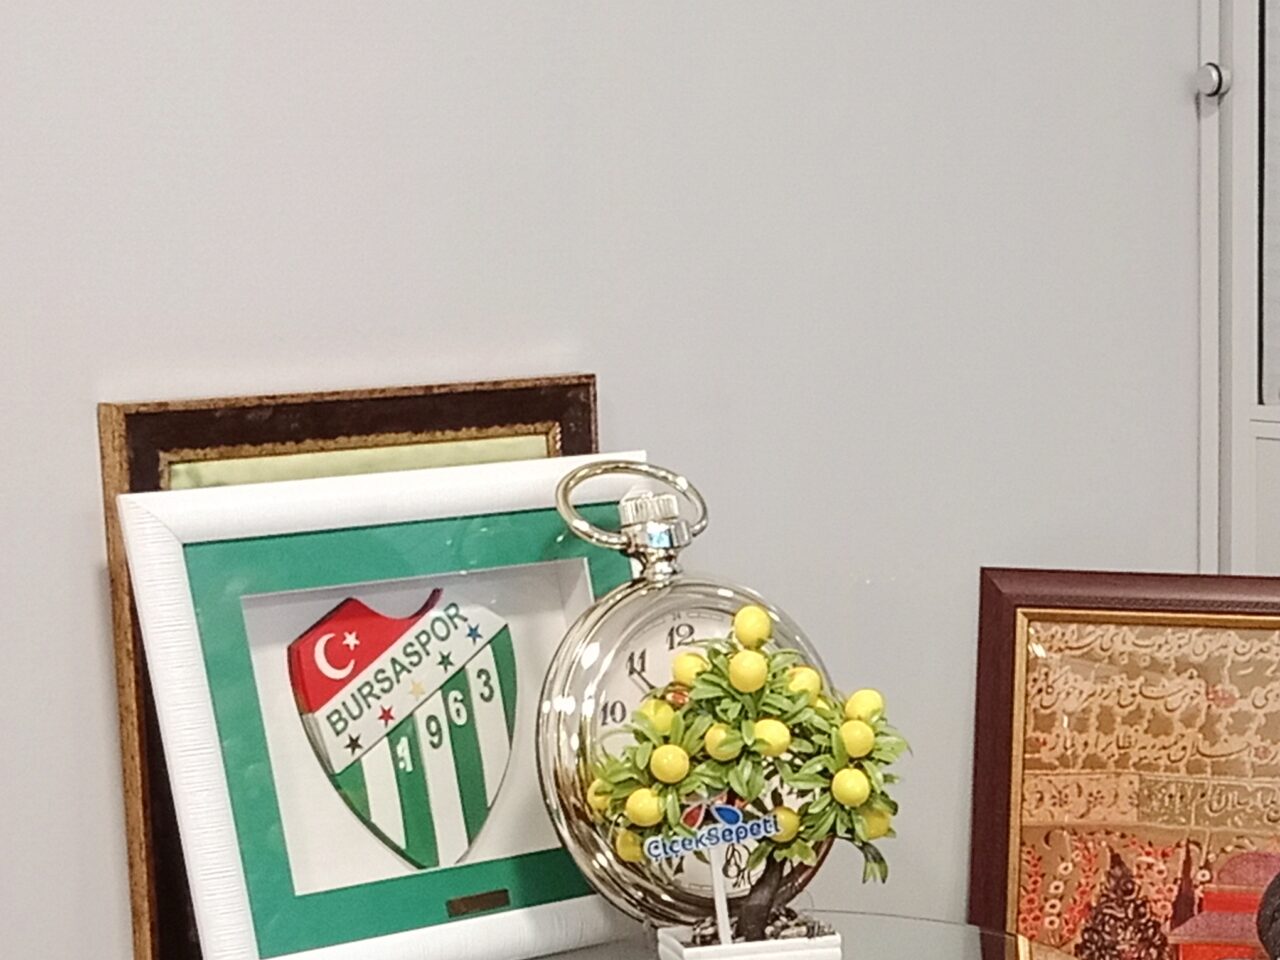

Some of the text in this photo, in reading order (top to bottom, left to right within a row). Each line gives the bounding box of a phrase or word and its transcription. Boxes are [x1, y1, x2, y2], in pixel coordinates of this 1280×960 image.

[667, 623, 695, 650] 12
[326, 602, 468, 737] BURSASPOR
[628, 648, 647, 676] 11
[601, 700, 626, 726] 10
